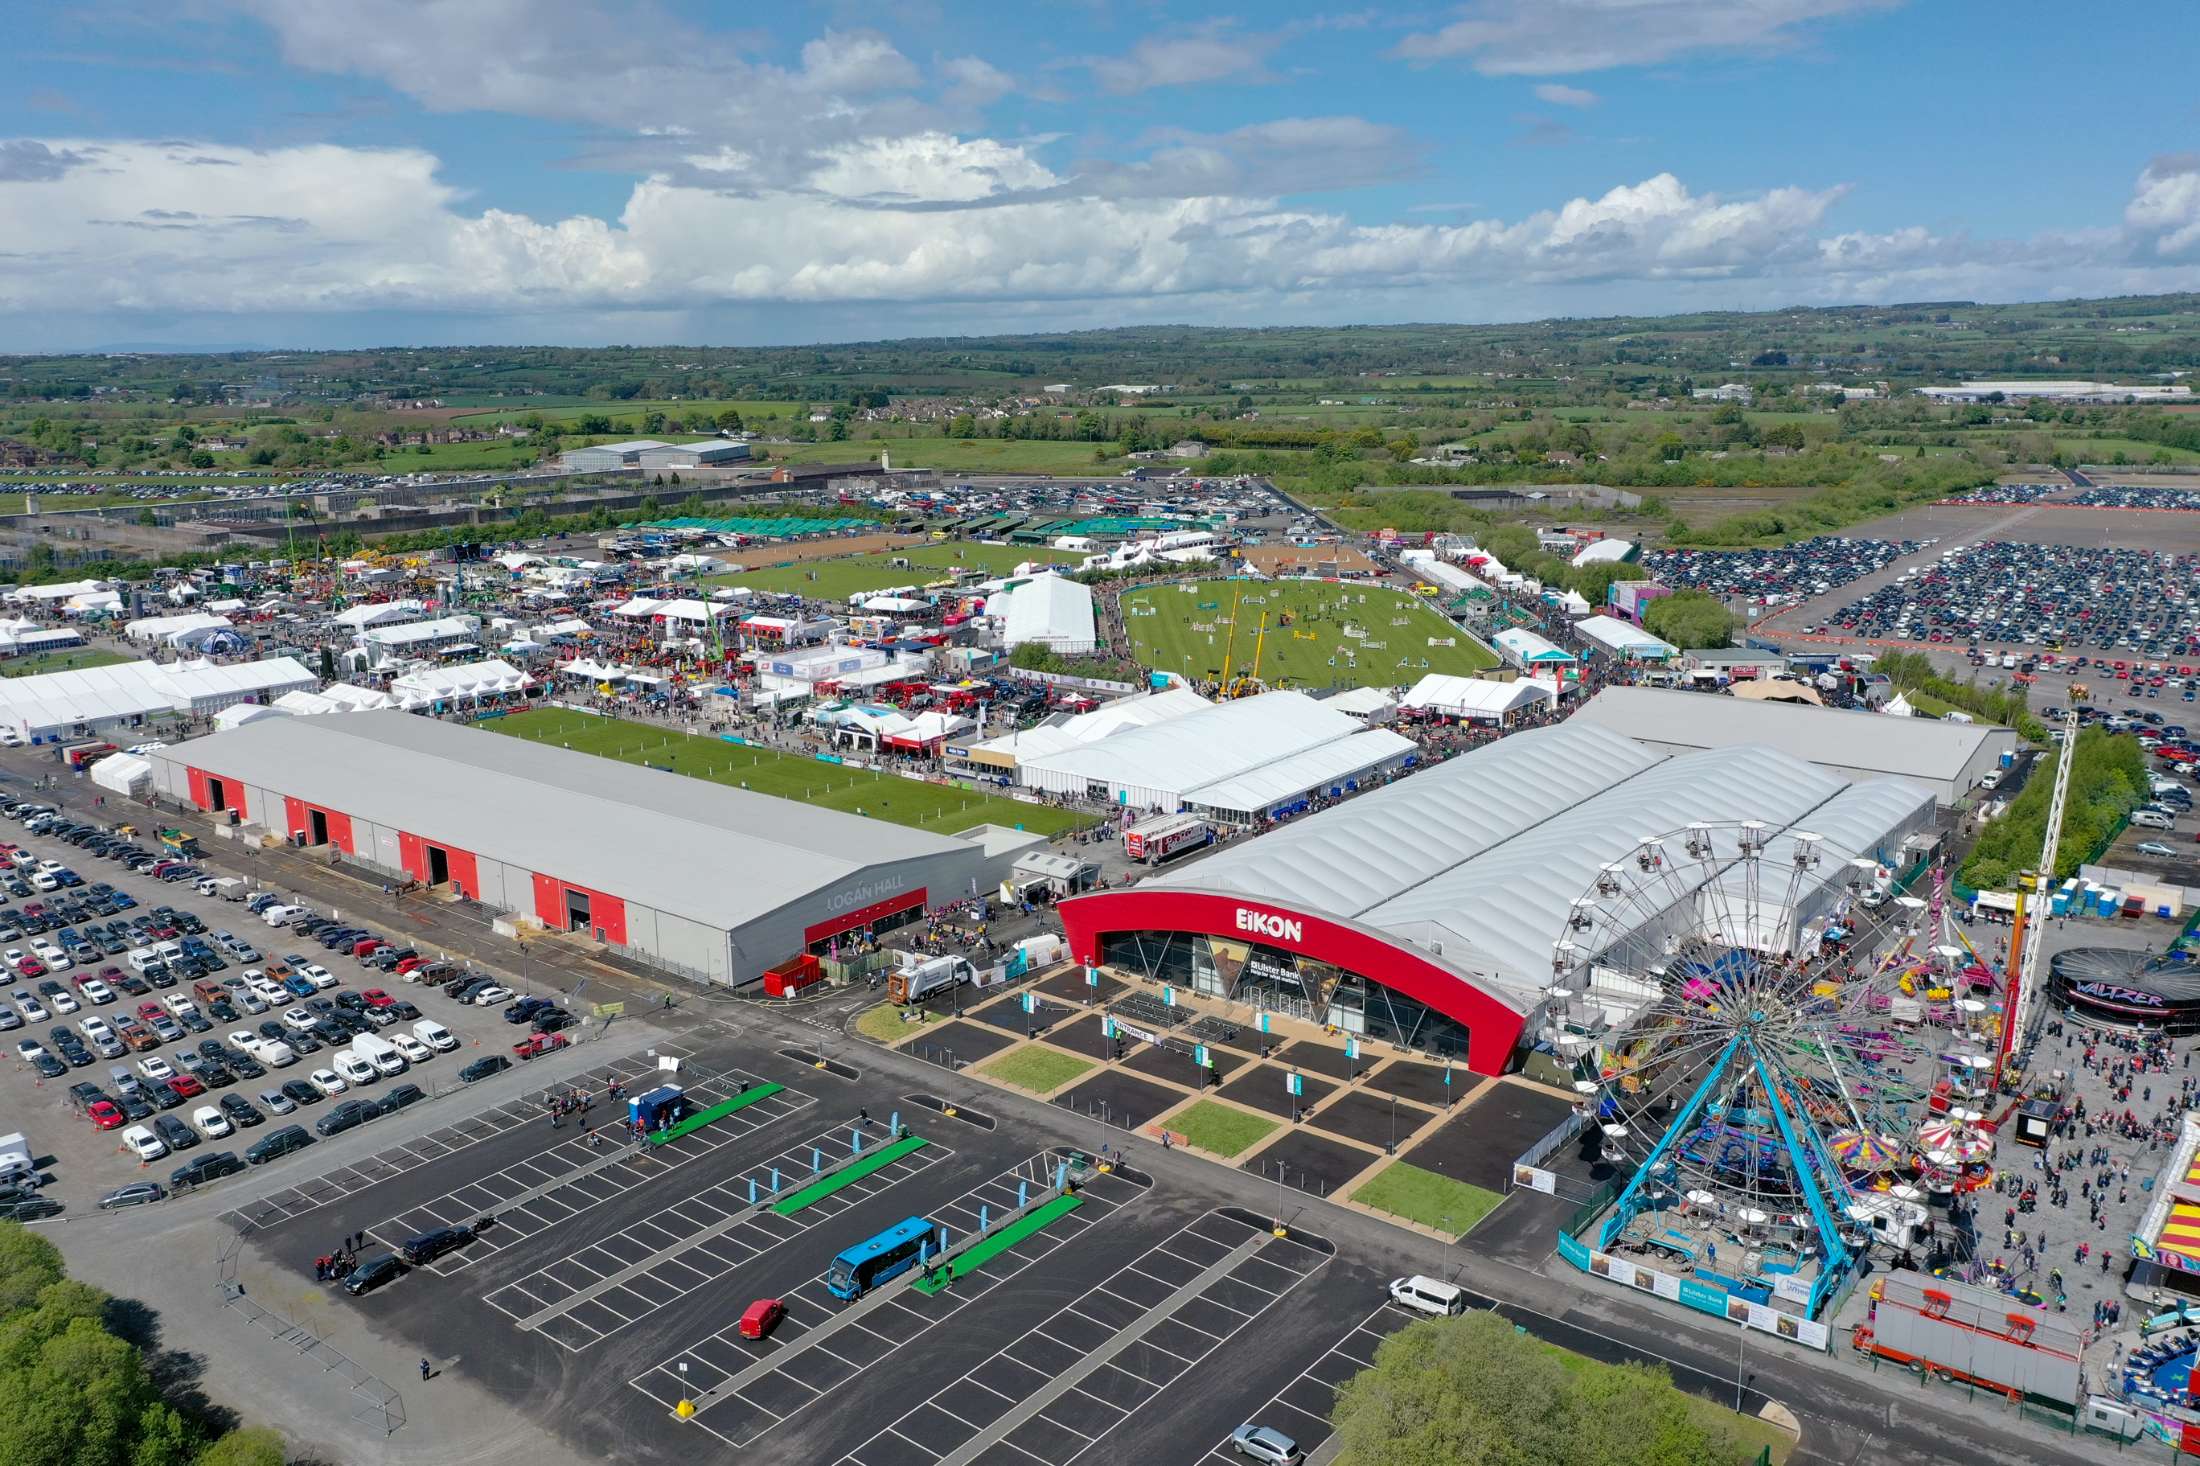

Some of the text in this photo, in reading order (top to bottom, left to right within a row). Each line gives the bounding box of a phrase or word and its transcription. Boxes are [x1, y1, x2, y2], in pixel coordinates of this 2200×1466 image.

[827, 874, 904, 911] LOGAN HALL
[1257, 962, 1299, 980] Ulster Bank
[2076, 981, 2164, 1007] WALTZER
[1116, 1021, 1149, 1040] ENTRANCE
